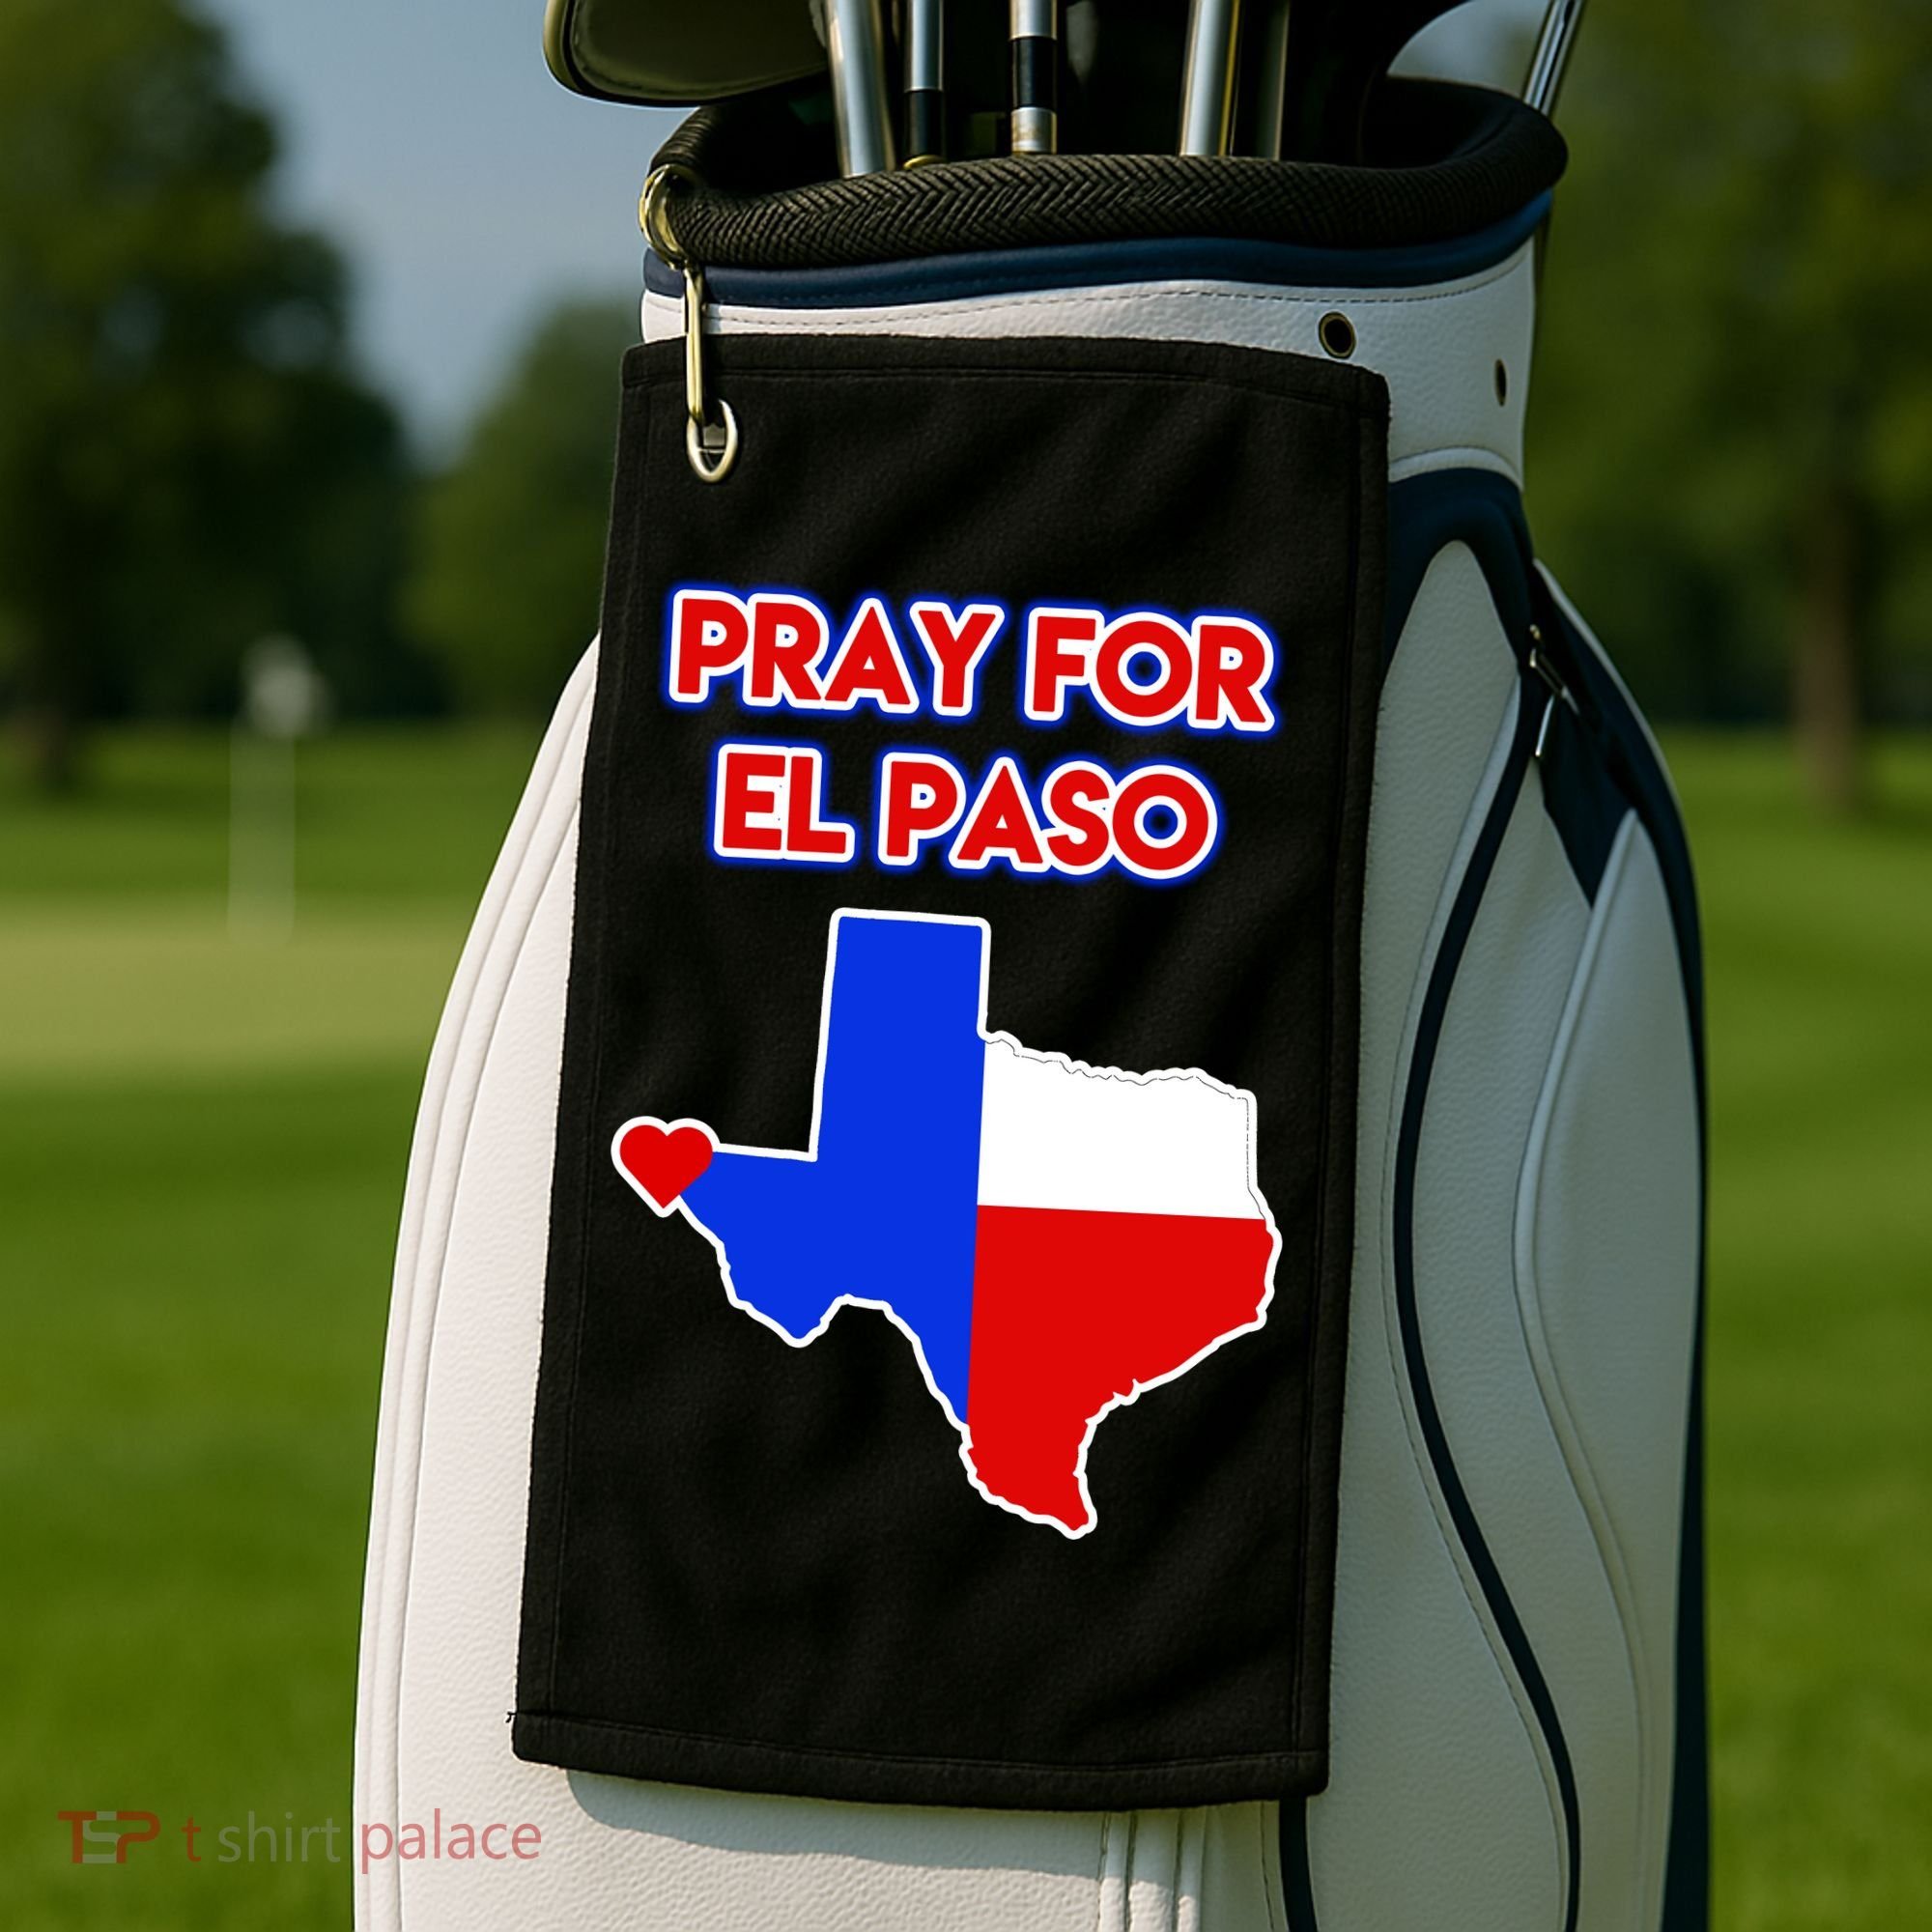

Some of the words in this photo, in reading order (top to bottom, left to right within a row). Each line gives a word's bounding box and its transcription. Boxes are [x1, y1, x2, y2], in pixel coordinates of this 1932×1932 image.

[669, 590, 1004, 716] PRAY
[1025, 608, 1274, 731] FOR
[715, 745, 854, 862] EL
[879, 753, 1216, 878] PASO
